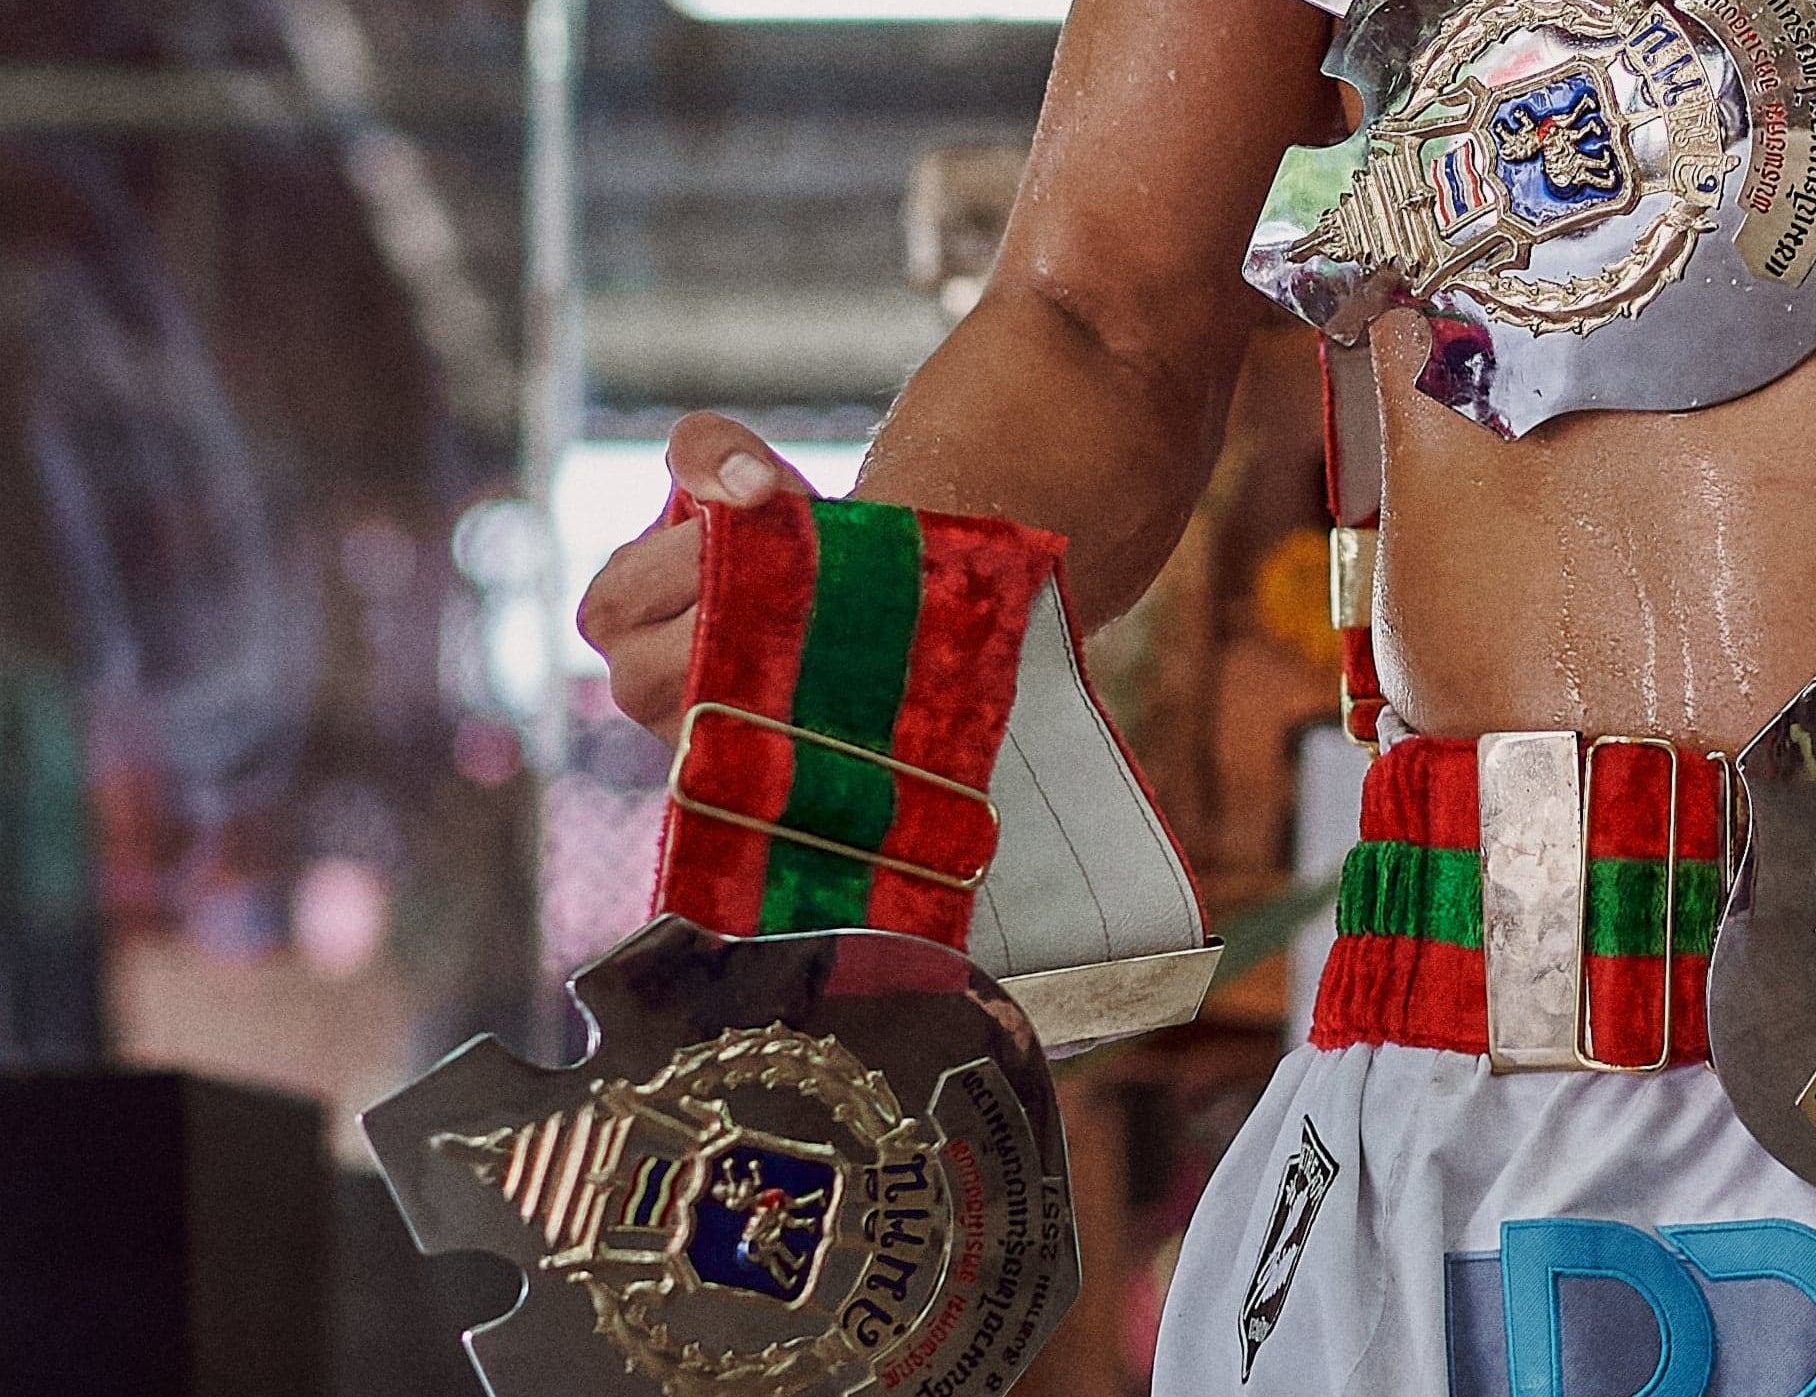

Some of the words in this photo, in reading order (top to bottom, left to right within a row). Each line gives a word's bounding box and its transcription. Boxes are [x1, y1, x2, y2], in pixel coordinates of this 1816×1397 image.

[1622, 13, 1741, 199] ลุมพินี
[843, 1154, 928, 1347] ลุมพินี
[985, 1372, 1003, 1392] 8
[1003, 1275, 1050, 1365] สิงหาคม
[1041, 1184, 1060, 1260] 2557
